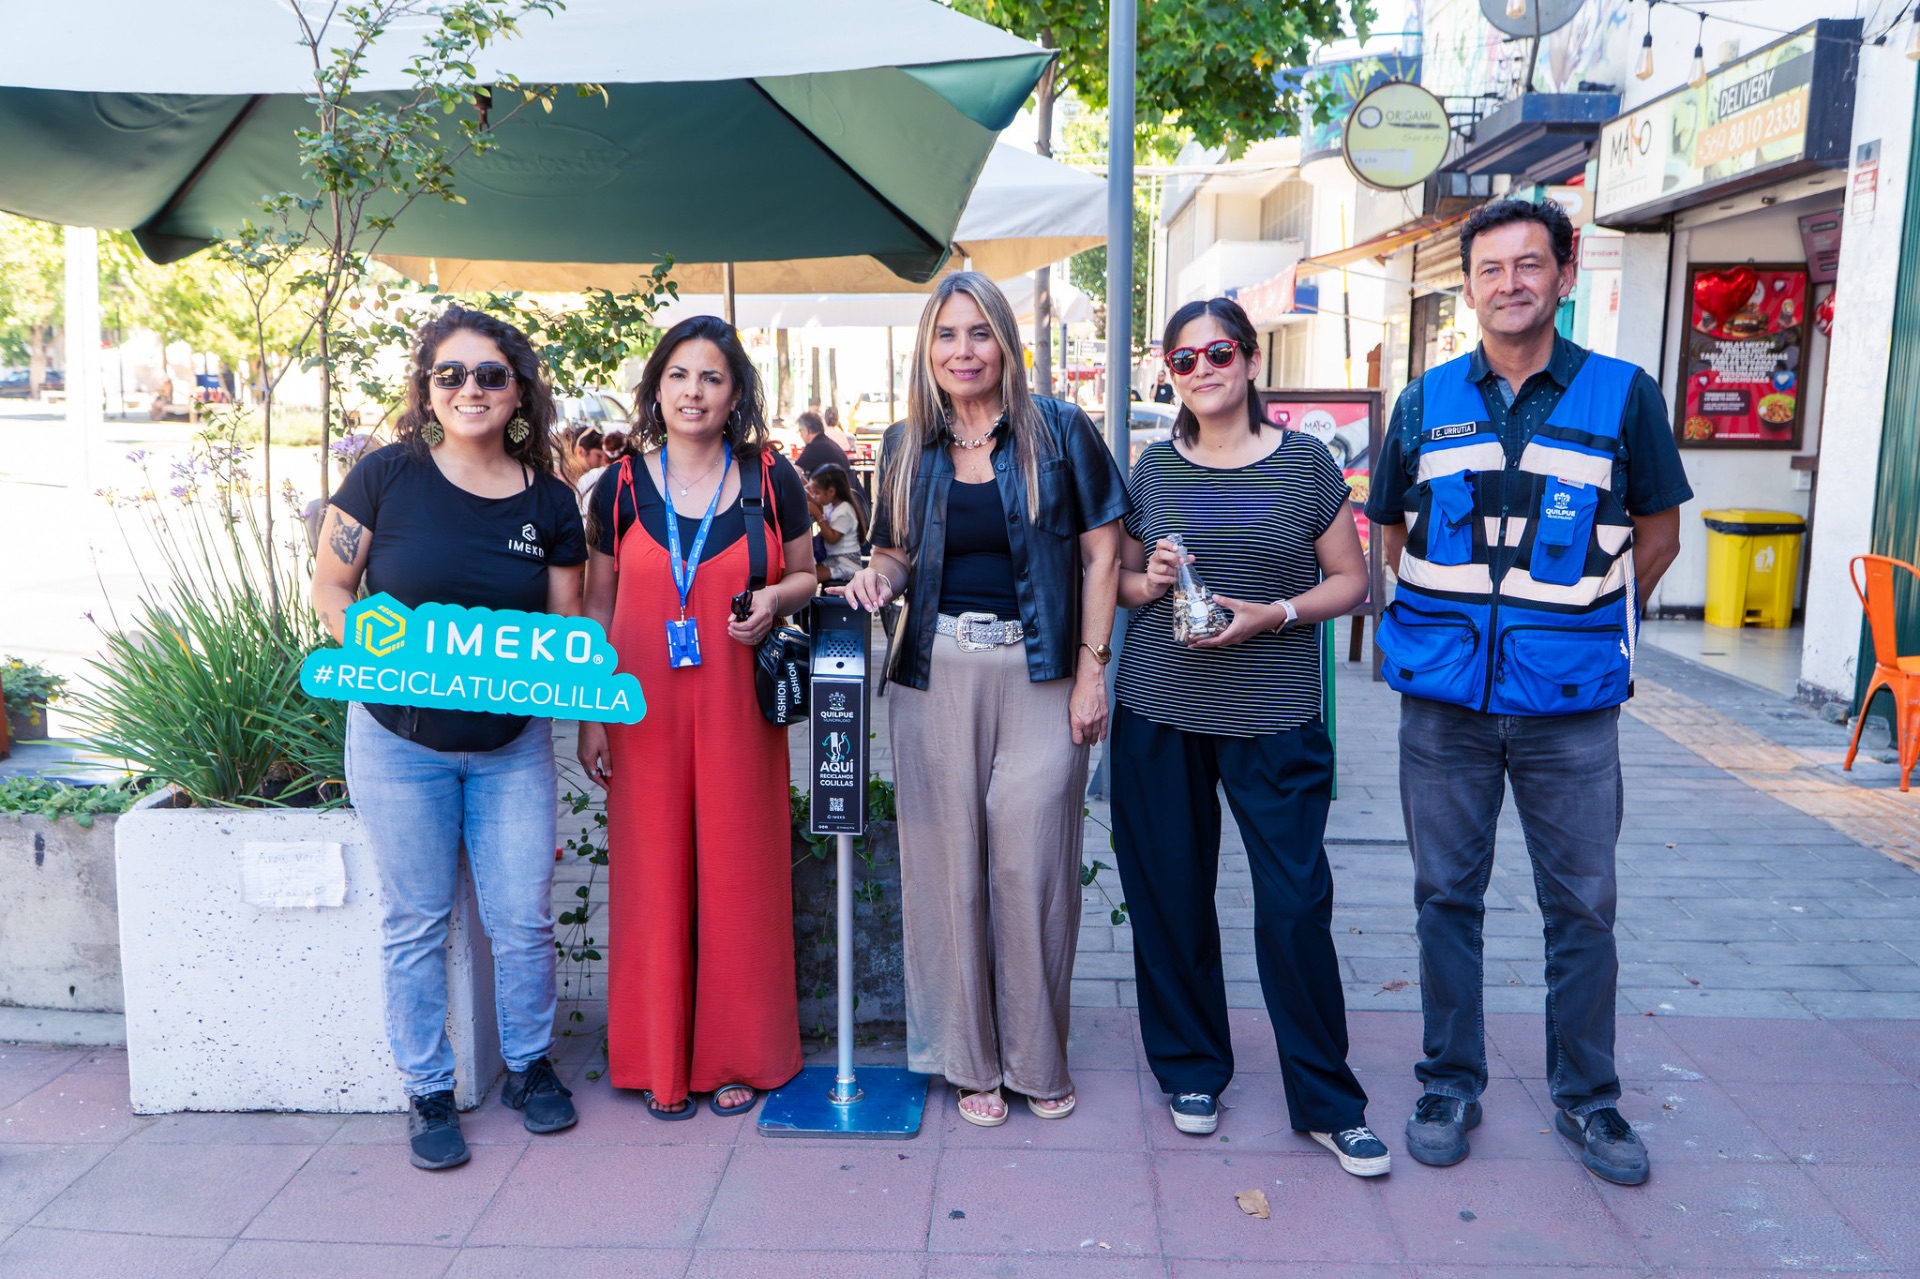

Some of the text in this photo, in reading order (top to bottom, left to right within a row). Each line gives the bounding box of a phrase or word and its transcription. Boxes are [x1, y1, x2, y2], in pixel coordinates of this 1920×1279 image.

[1720, 68, 1775, 117] DELIVERY
[1385, 110, 1432, 121] ORIGAMI
[1728, 114, 1762, 152] 8810
[1764, 98, 1800, 139] 2338
[1444, 424, 1472, 435] URRUTIA
[508, 539, 545, 558] IMEKO
[313, 664, 631, 712] #RECICLATUCOLILLA
[787, 662, 802, 705] FASHION
[777, 680, 787, 723] FASHION
[820, 758, 854, 773] AQUÍ
[820, 779, 854, 787] COLILLAS
